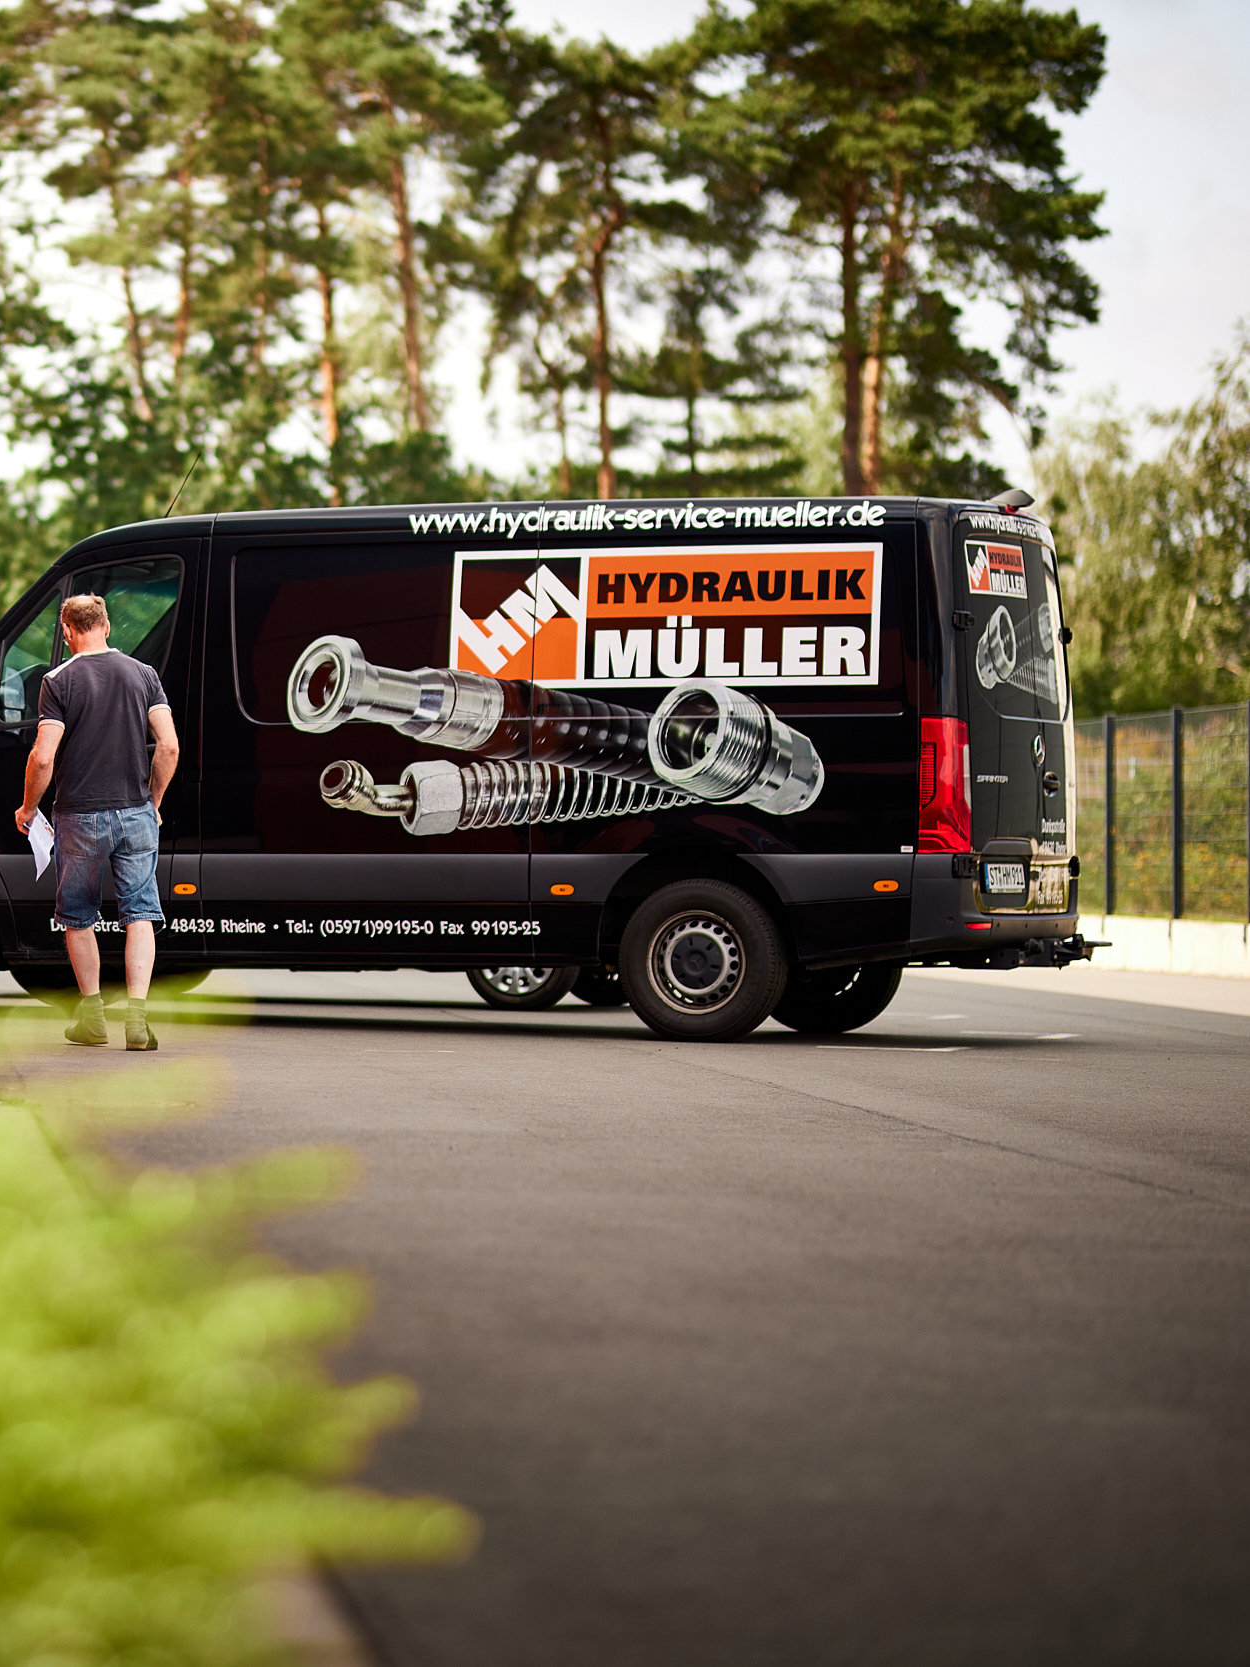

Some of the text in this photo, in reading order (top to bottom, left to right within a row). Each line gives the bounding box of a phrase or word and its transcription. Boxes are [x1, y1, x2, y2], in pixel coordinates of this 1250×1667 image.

[409, 500, 886, 539] www.hydraulik-service-mueller.de
[988, 551, 1023, 568] HYDRAULIK
[596, 568, 867, 604] HYDRAULIK
[990, 568, 1027, 595] MÜLLER
[593, 615, 867, 679] MÜLLER
[170, 918, 215, 933] 48432
[220, 918, 266, 934] Rheine
[319, 919, 434, 938] (05971)99195-0
[440, 920, 465, 935] Fax
[471, 920, 541, 936] 99195-25
